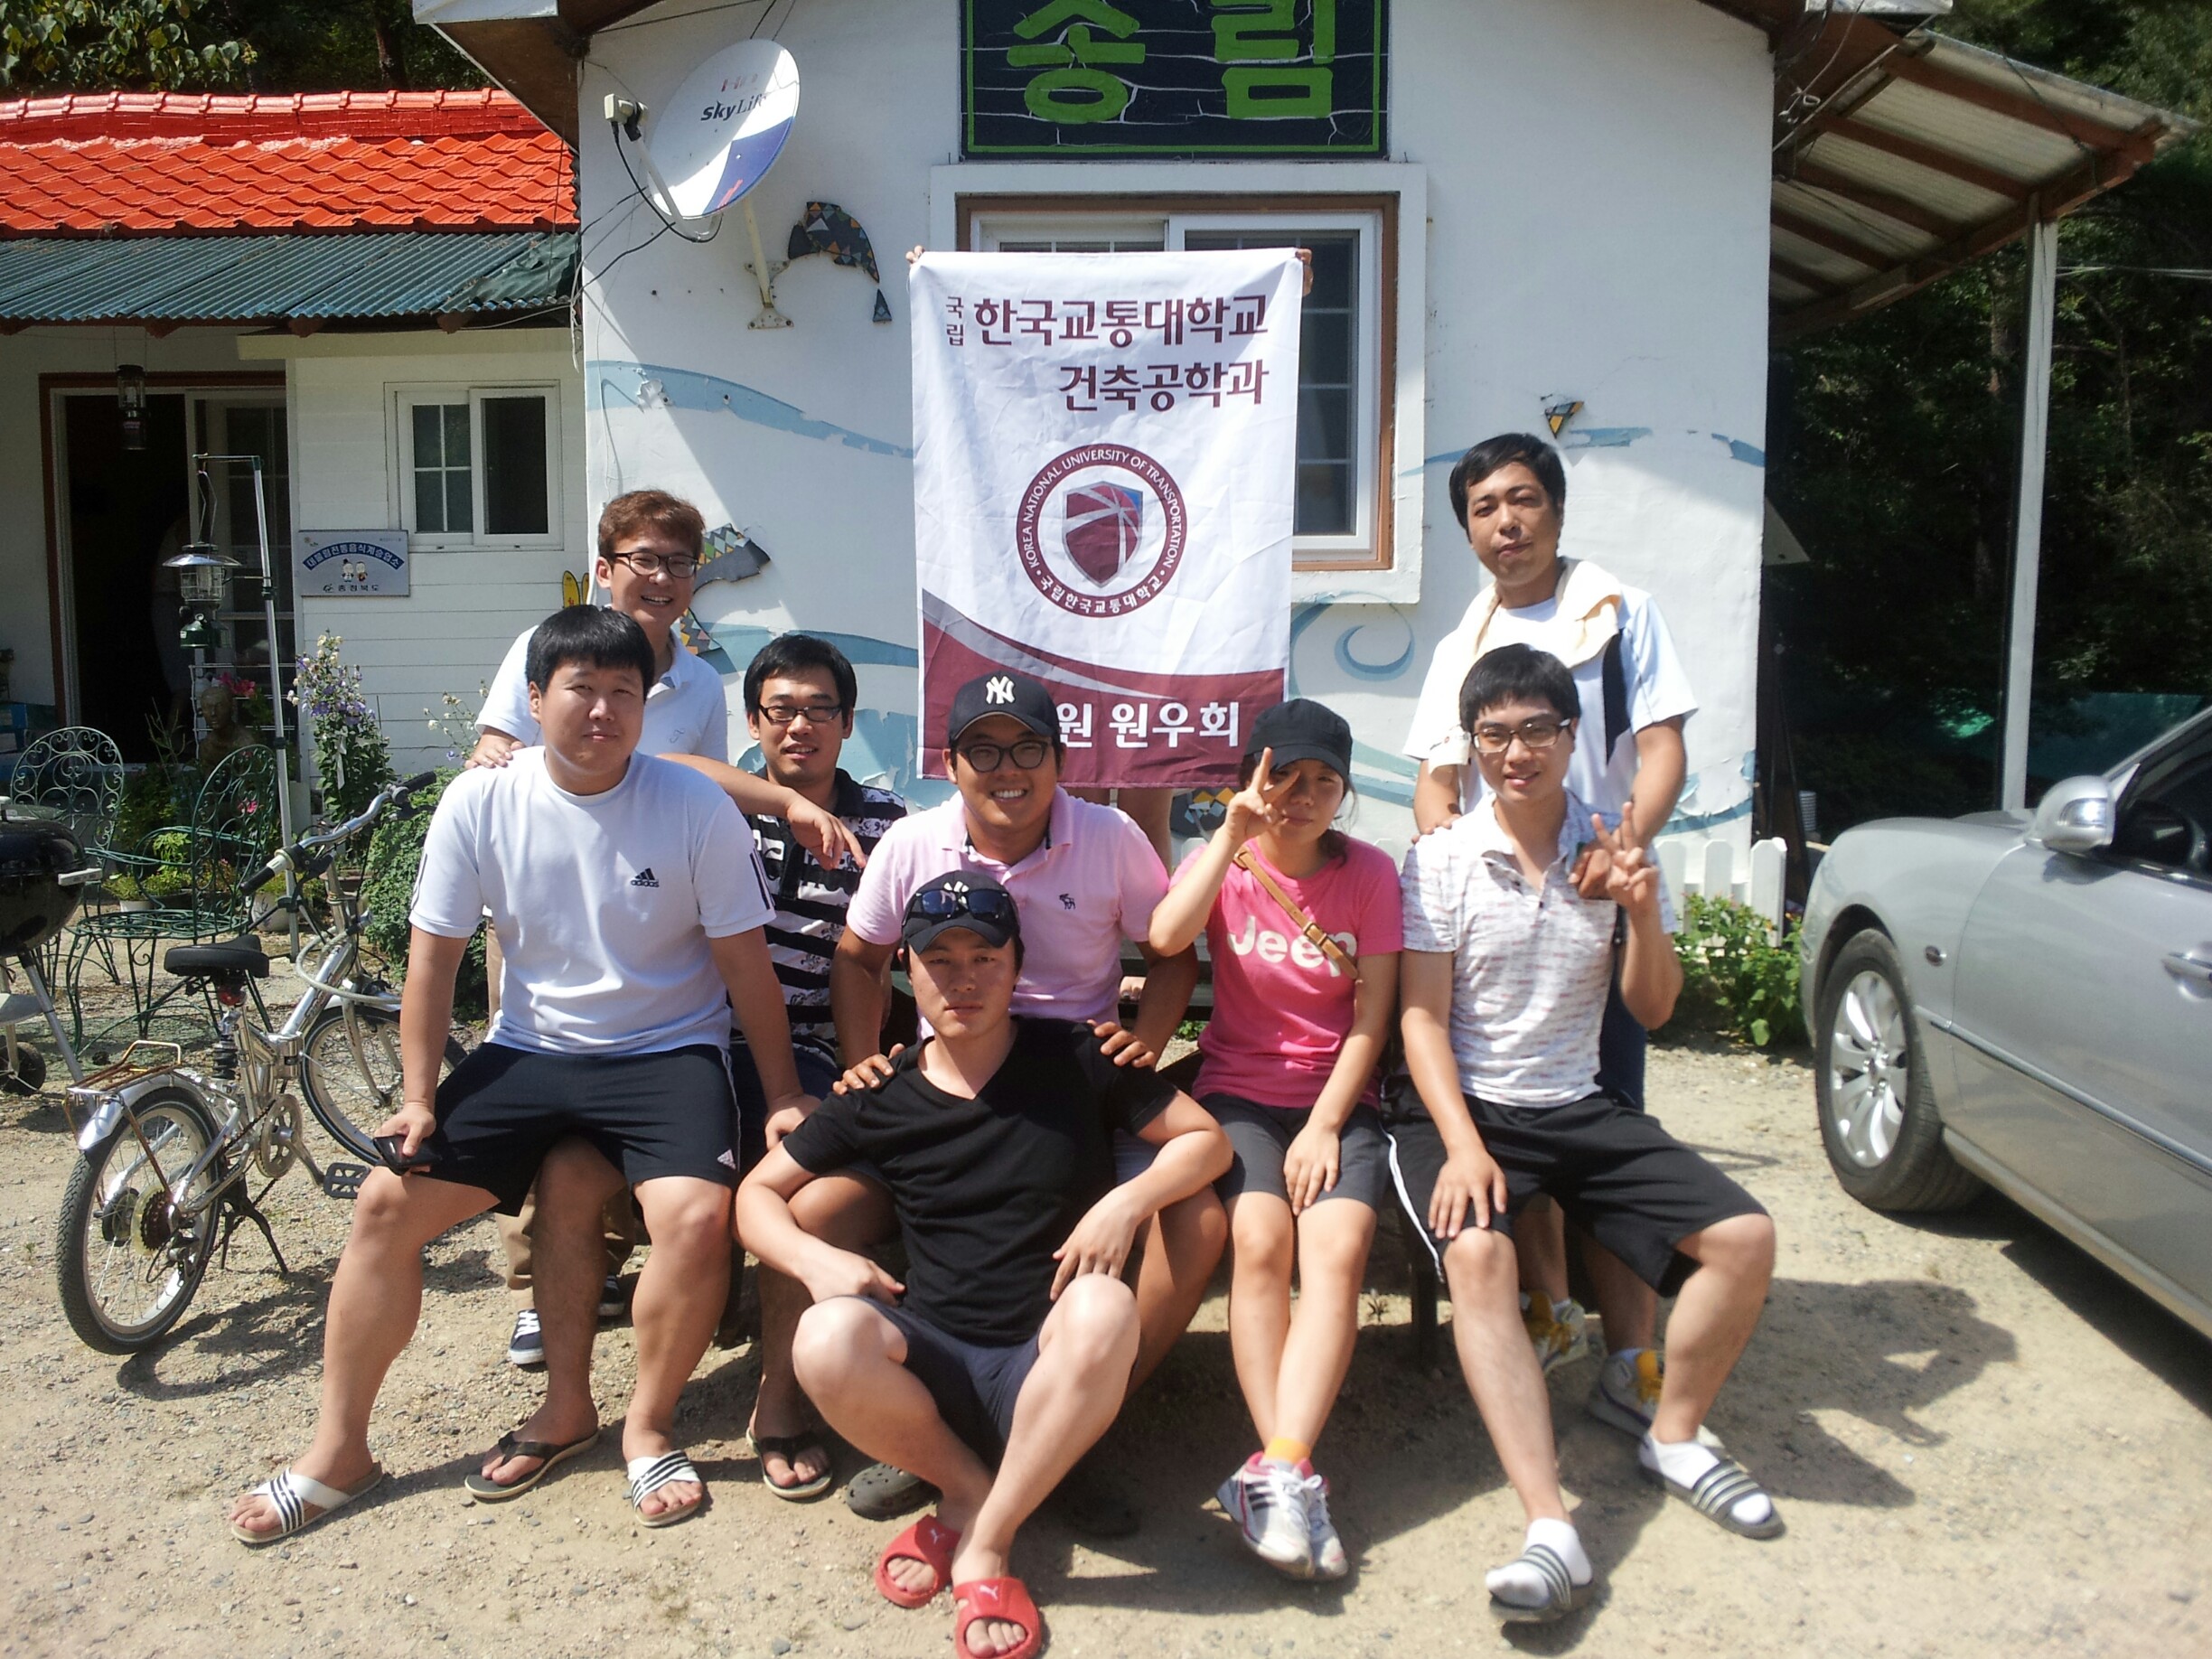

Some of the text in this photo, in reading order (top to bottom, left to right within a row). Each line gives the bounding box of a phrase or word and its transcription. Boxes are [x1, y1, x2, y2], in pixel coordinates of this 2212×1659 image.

[1007, 0, 1336, 124] 송림
[946, 295, 1269, 349] 국립 한국교통대학교
[1058, 359, 1270, 412] 건축공학과
[1023, 449, 1182, 568] KOREA NATIONAL UNIVERSITY OF TRANSPORTATION
[1041, 575, 1163, 614] 국립한국교통대학교
[986, 676, 1015, 704] NY
[1109, 702, 1239, 748] 원우회
[631, 879, 660, 887] adidas
[1227, 914, 1357, 977] Jeep
